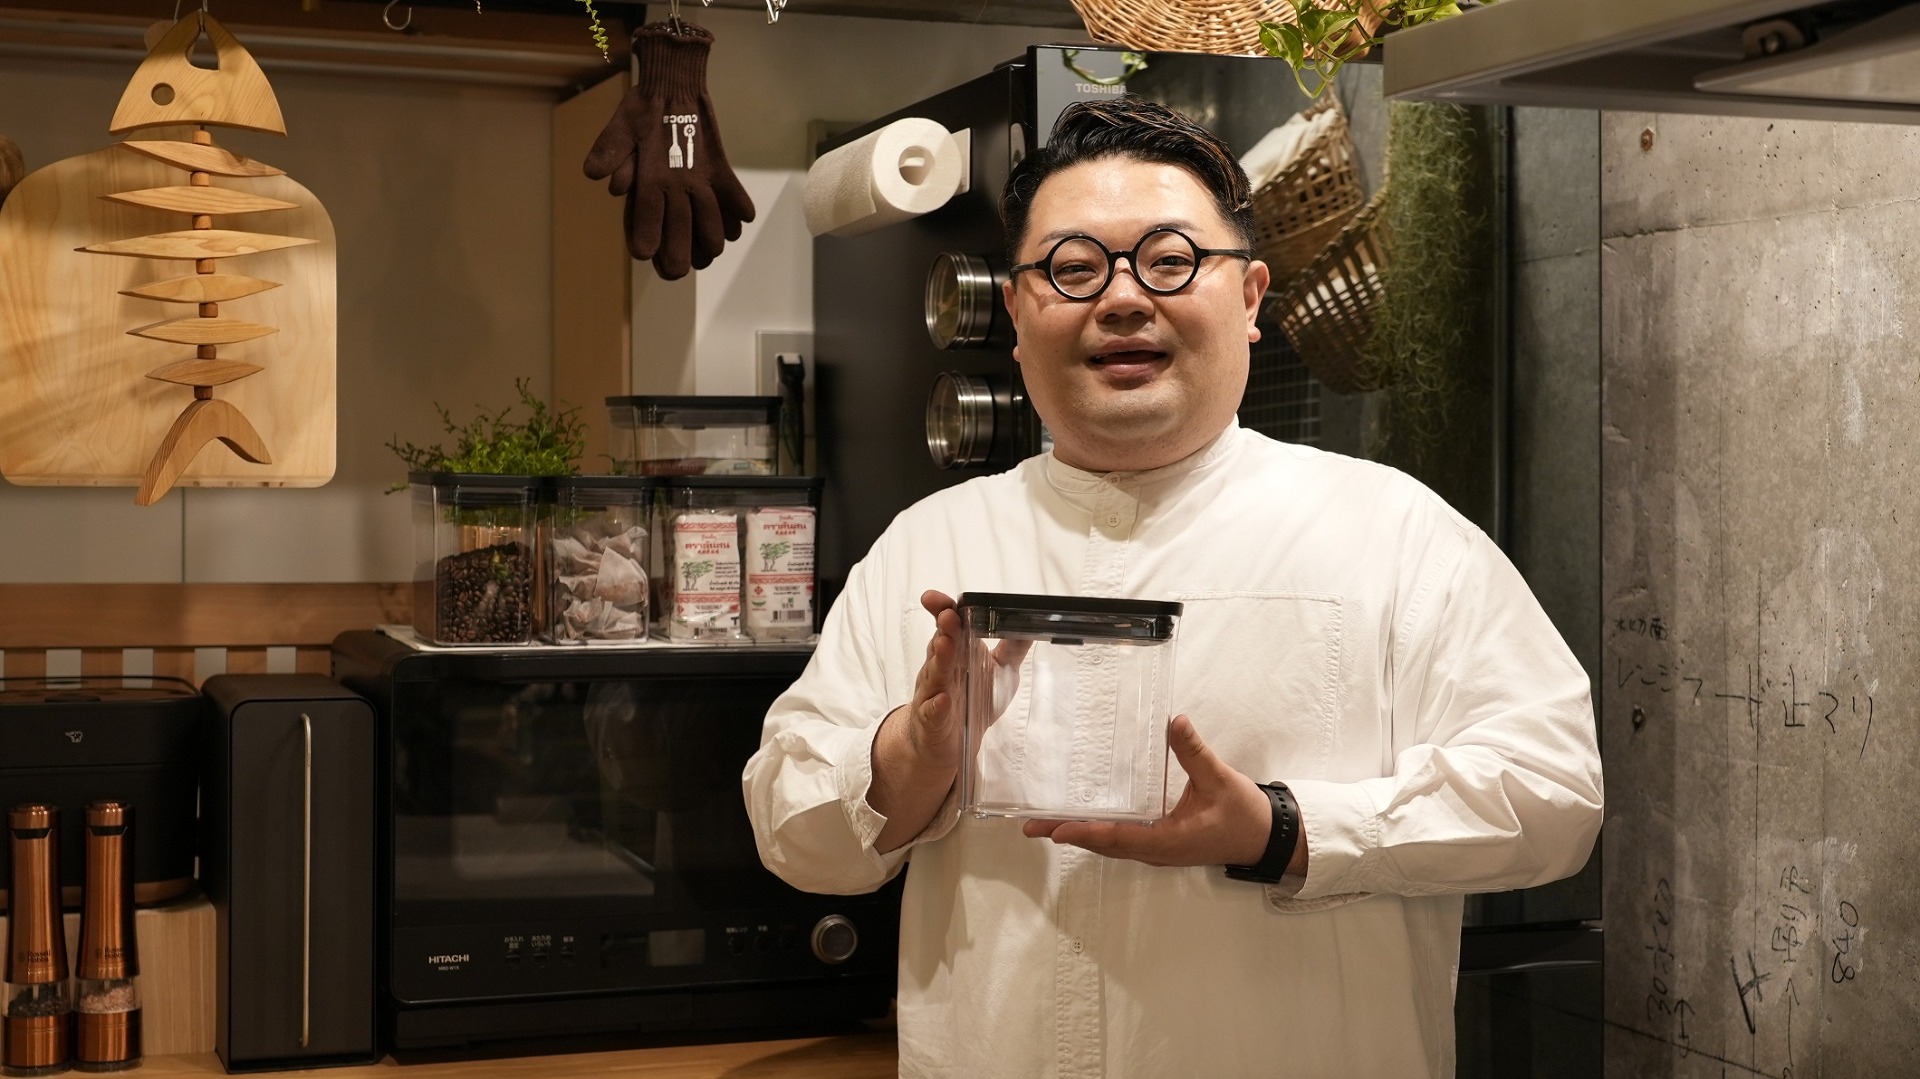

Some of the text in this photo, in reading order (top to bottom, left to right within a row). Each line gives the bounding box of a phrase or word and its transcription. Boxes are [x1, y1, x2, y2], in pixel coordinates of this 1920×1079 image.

[1075, 83, 1127, 95] TOSHIBA
[663, 114, 698, 124] cuoca
[1831, 900, 1859, 984] 840
[428, 954, 470, 964] HITACHI
